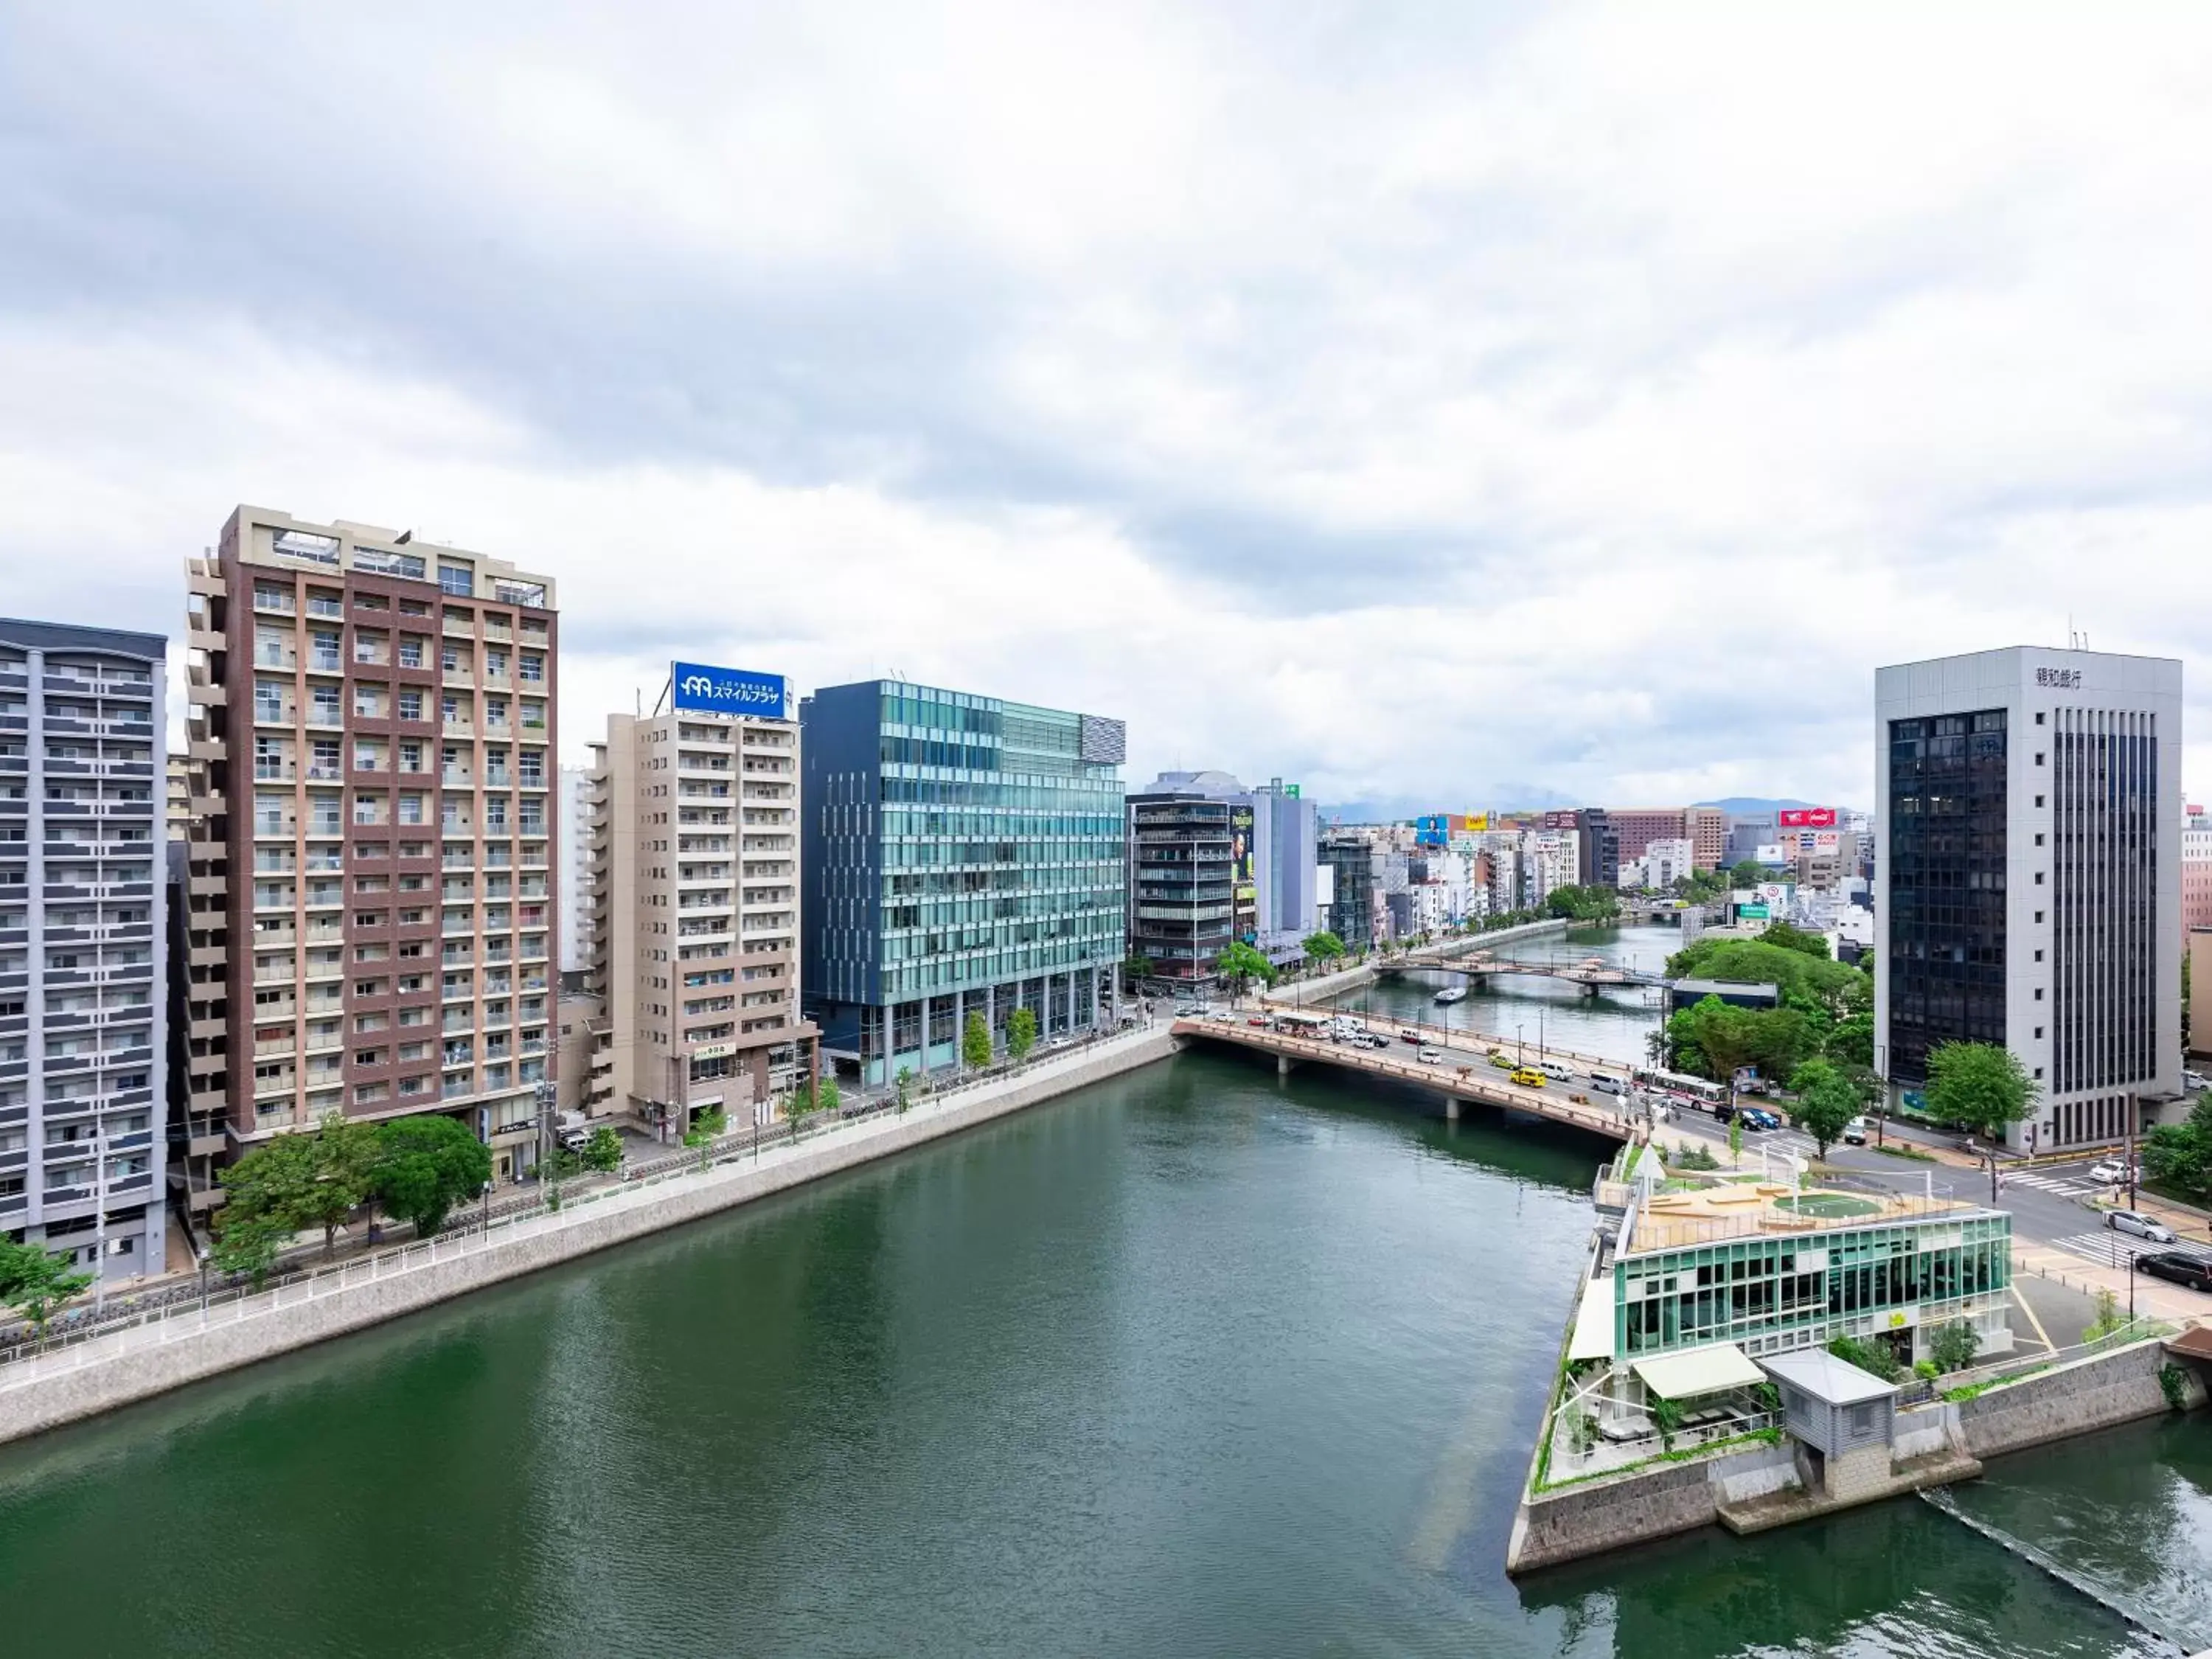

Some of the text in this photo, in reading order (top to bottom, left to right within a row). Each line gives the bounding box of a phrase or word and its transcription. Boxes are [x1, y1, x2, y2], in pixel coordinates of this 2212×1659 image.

[713, 686, 779, 705] スマイルプラザ
